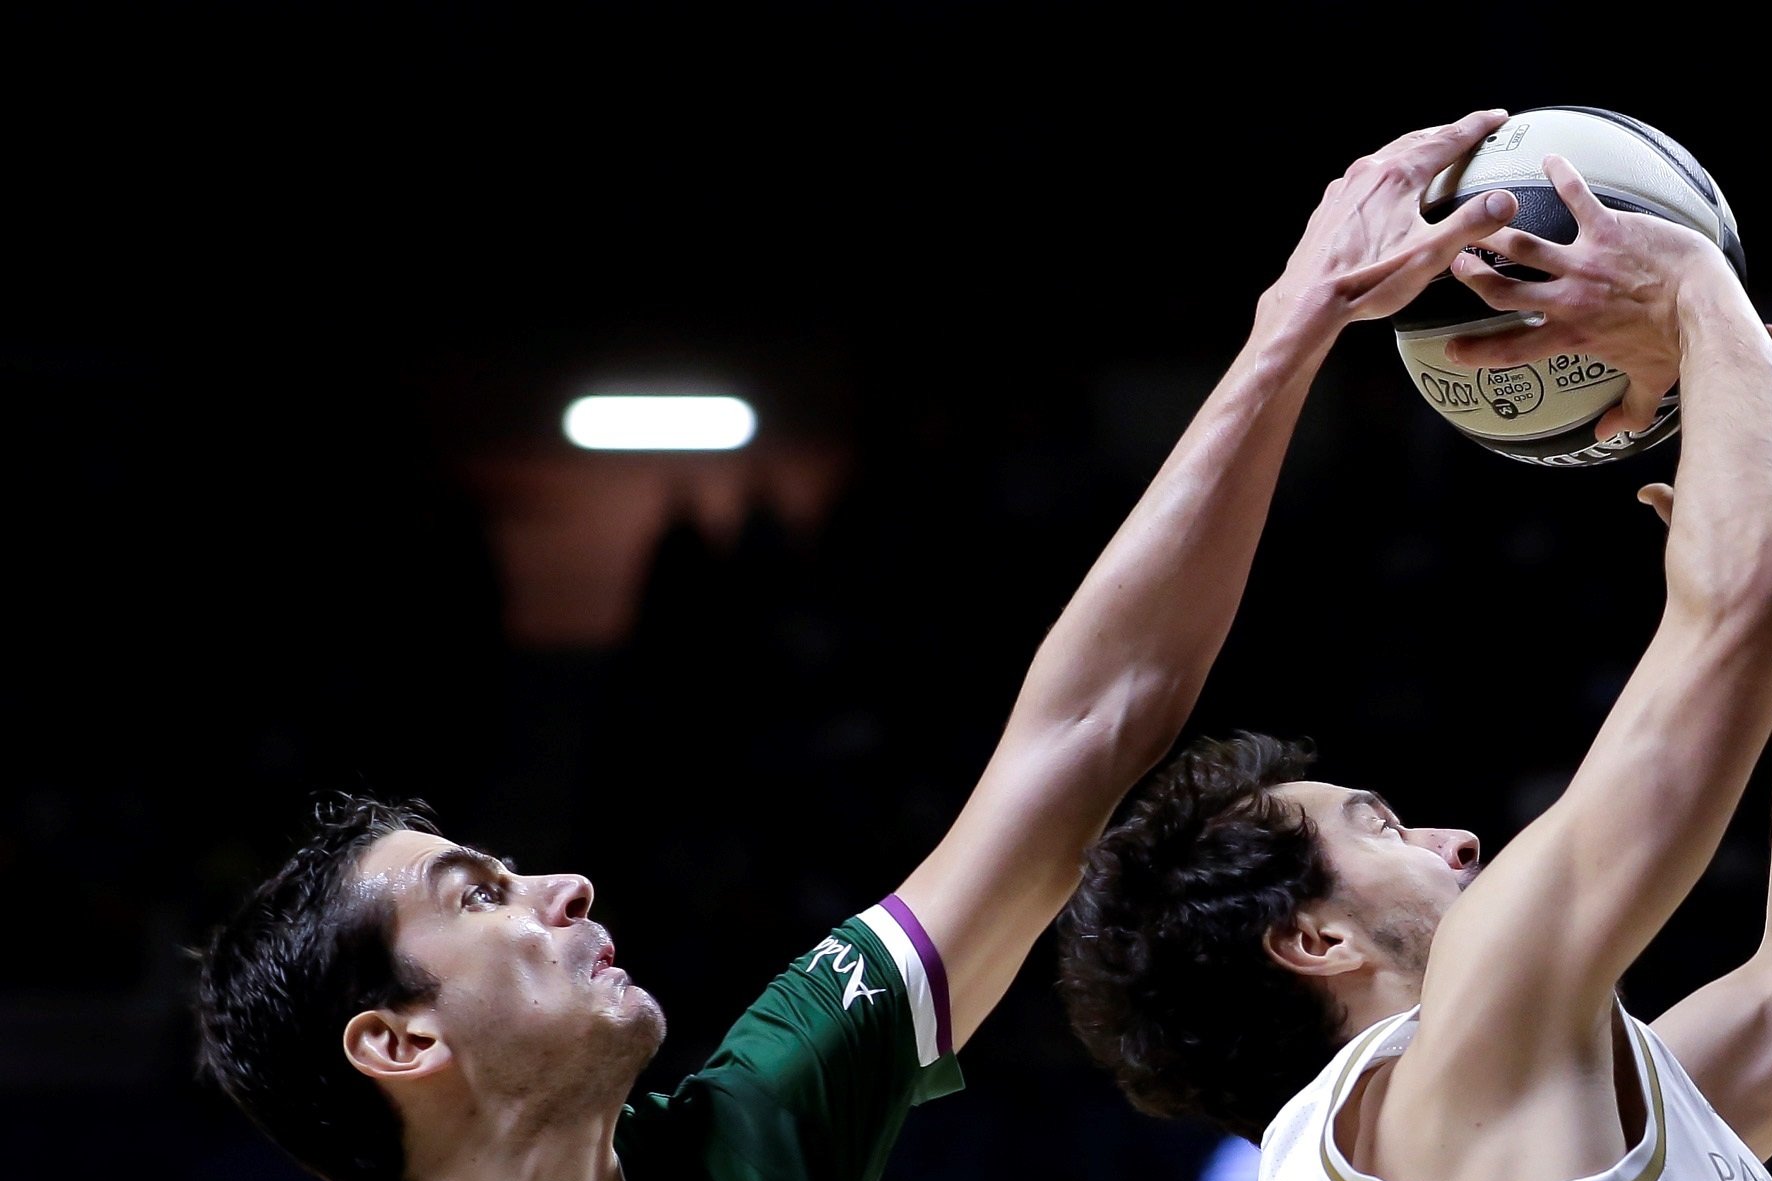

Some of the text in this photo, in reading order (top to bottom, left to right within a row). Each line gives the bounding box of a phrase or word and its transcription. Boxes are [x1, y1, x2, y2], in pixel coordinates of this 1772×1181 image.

[1487, 374, 1509, 386] rey
[1556, 362, 1617, 388] opa
[1421, 372, 1478, 407] 2020
[1493, 383, 1532, 396] copa
[1514, 393, 1533, 401] acb
